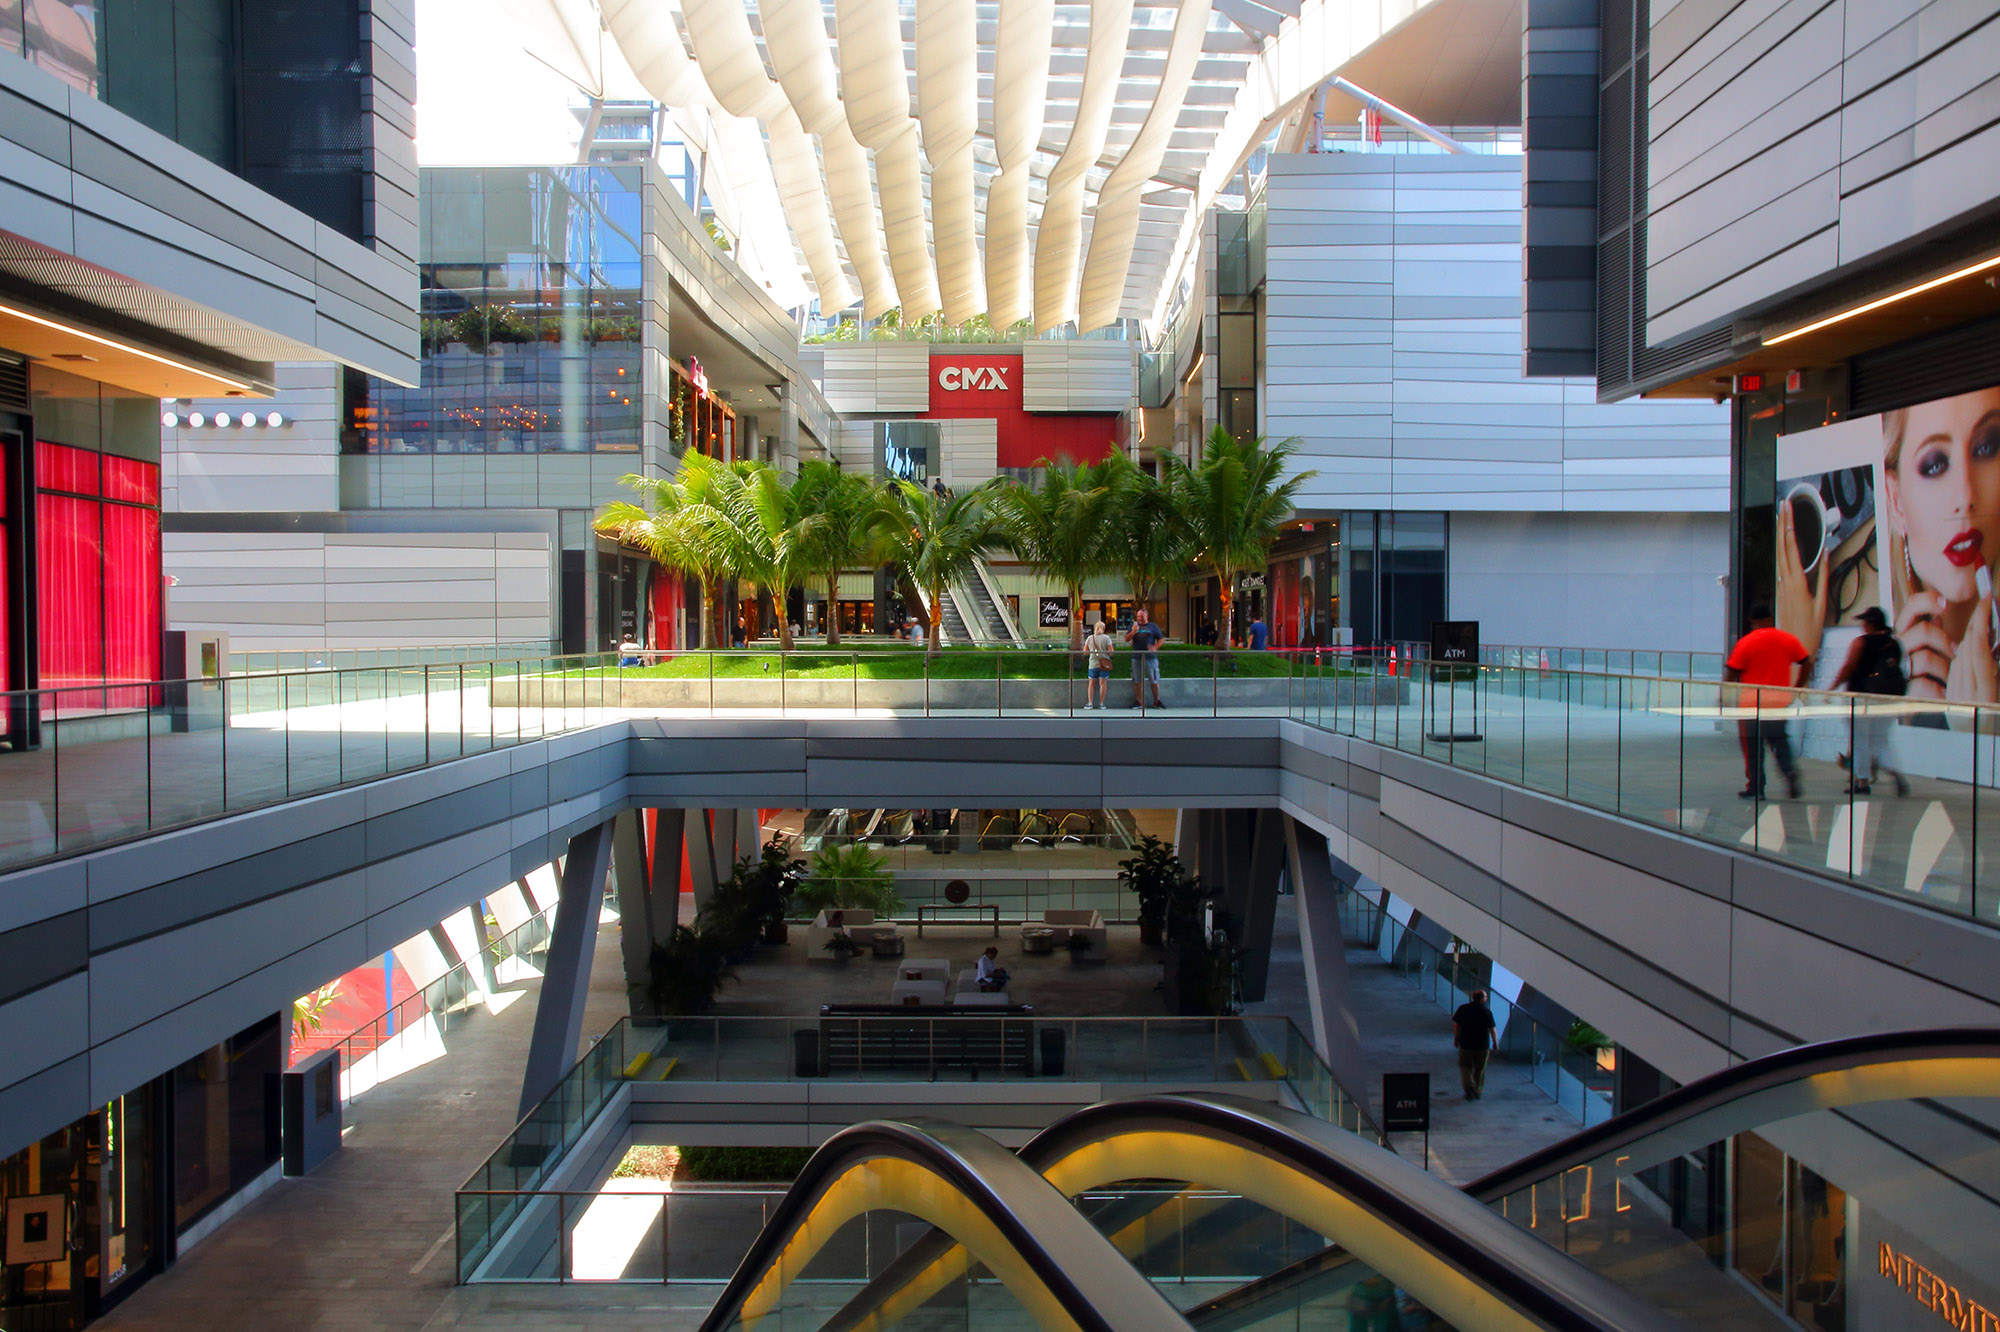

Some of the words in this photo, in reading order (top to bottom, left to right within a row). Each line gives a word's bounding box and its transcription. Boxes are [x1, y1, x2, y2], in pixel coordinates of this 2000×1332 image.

[938, 366, 1009, 391] CMX
[1742, 375, 1761, 391] EXIT
[1444, 648, 1466, 658] ATM
[1396, 1100, 1417, 1109] ATM
